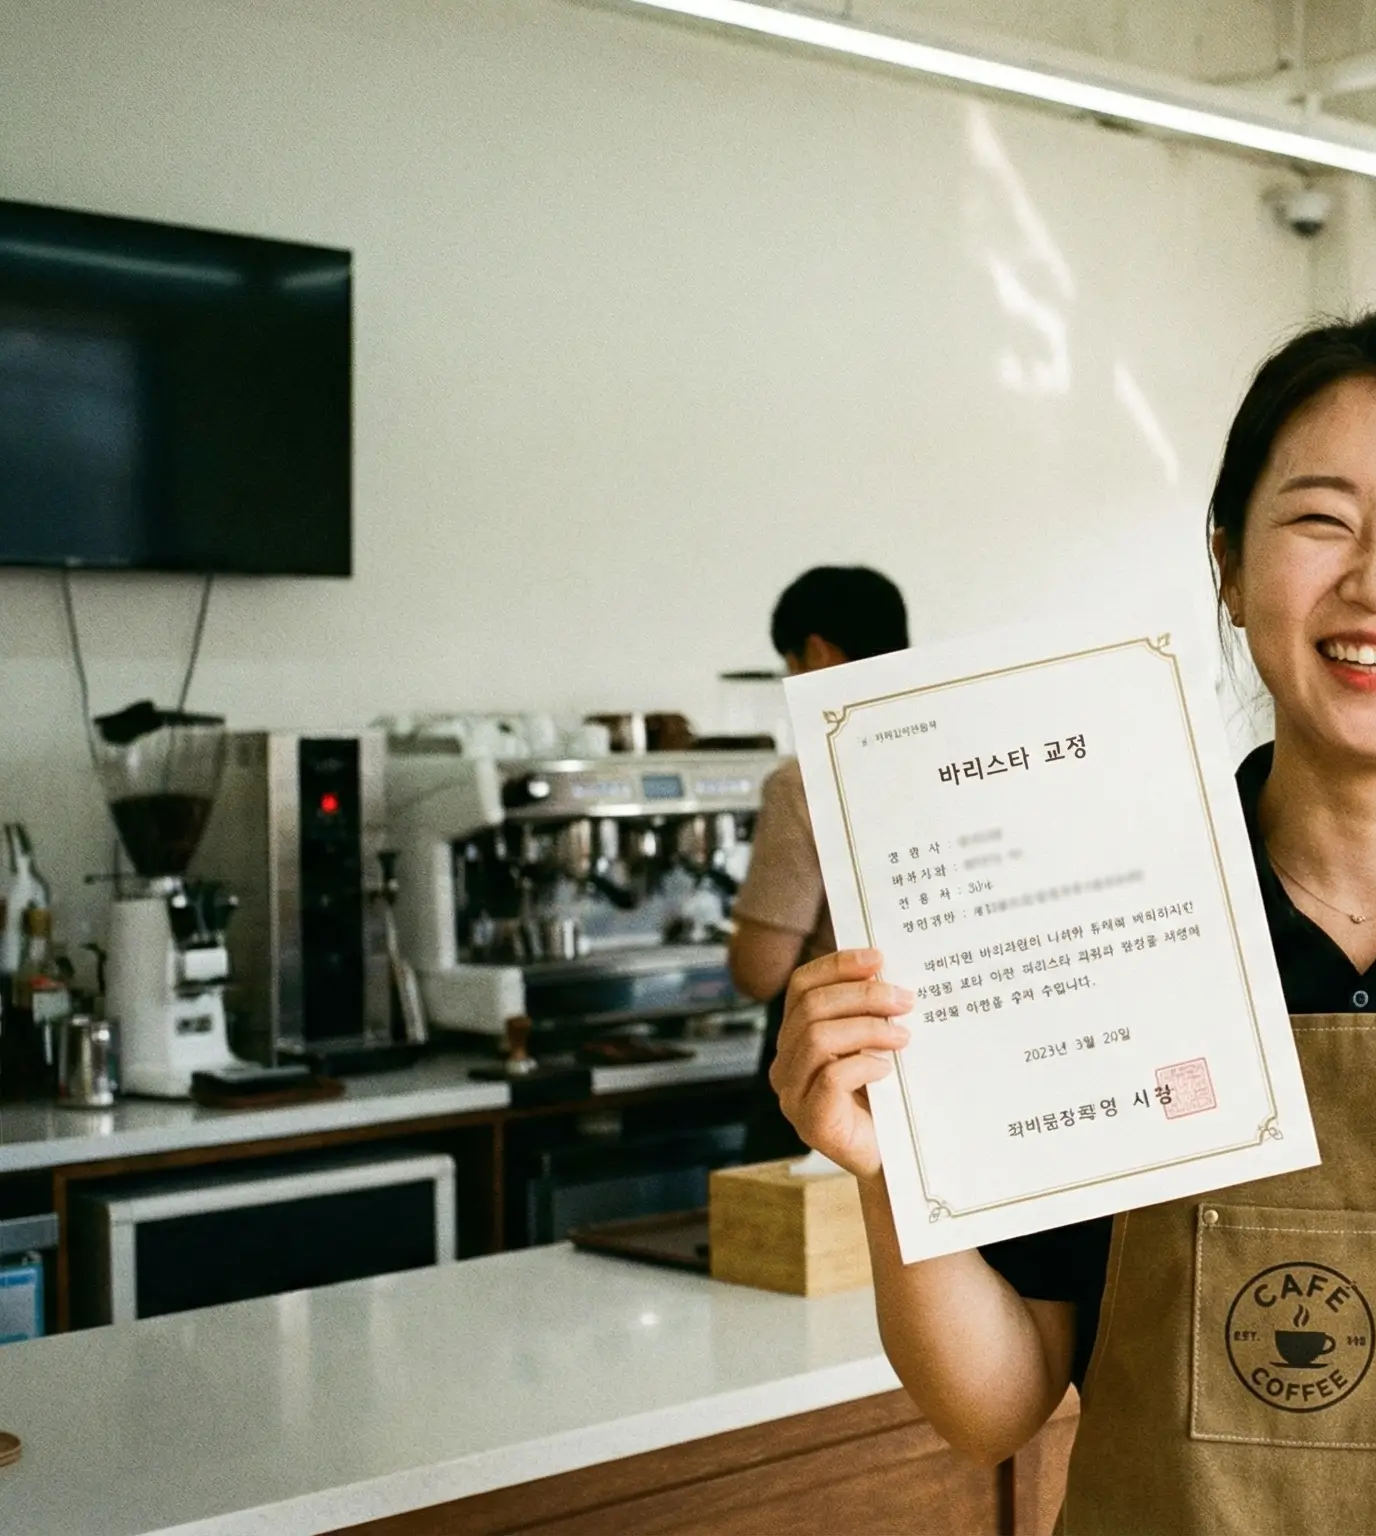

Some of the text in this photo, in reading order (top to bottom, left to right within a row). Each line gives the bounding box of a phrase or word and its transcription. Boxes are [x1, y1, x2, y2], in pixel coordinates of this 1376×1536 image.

[938, 734, 1087, 786] 바리스타 교정
[1024, 1026, 1131, 1063] 2023년 3월 20일
[1252, 1368, 1348, 1401] COFFEE
